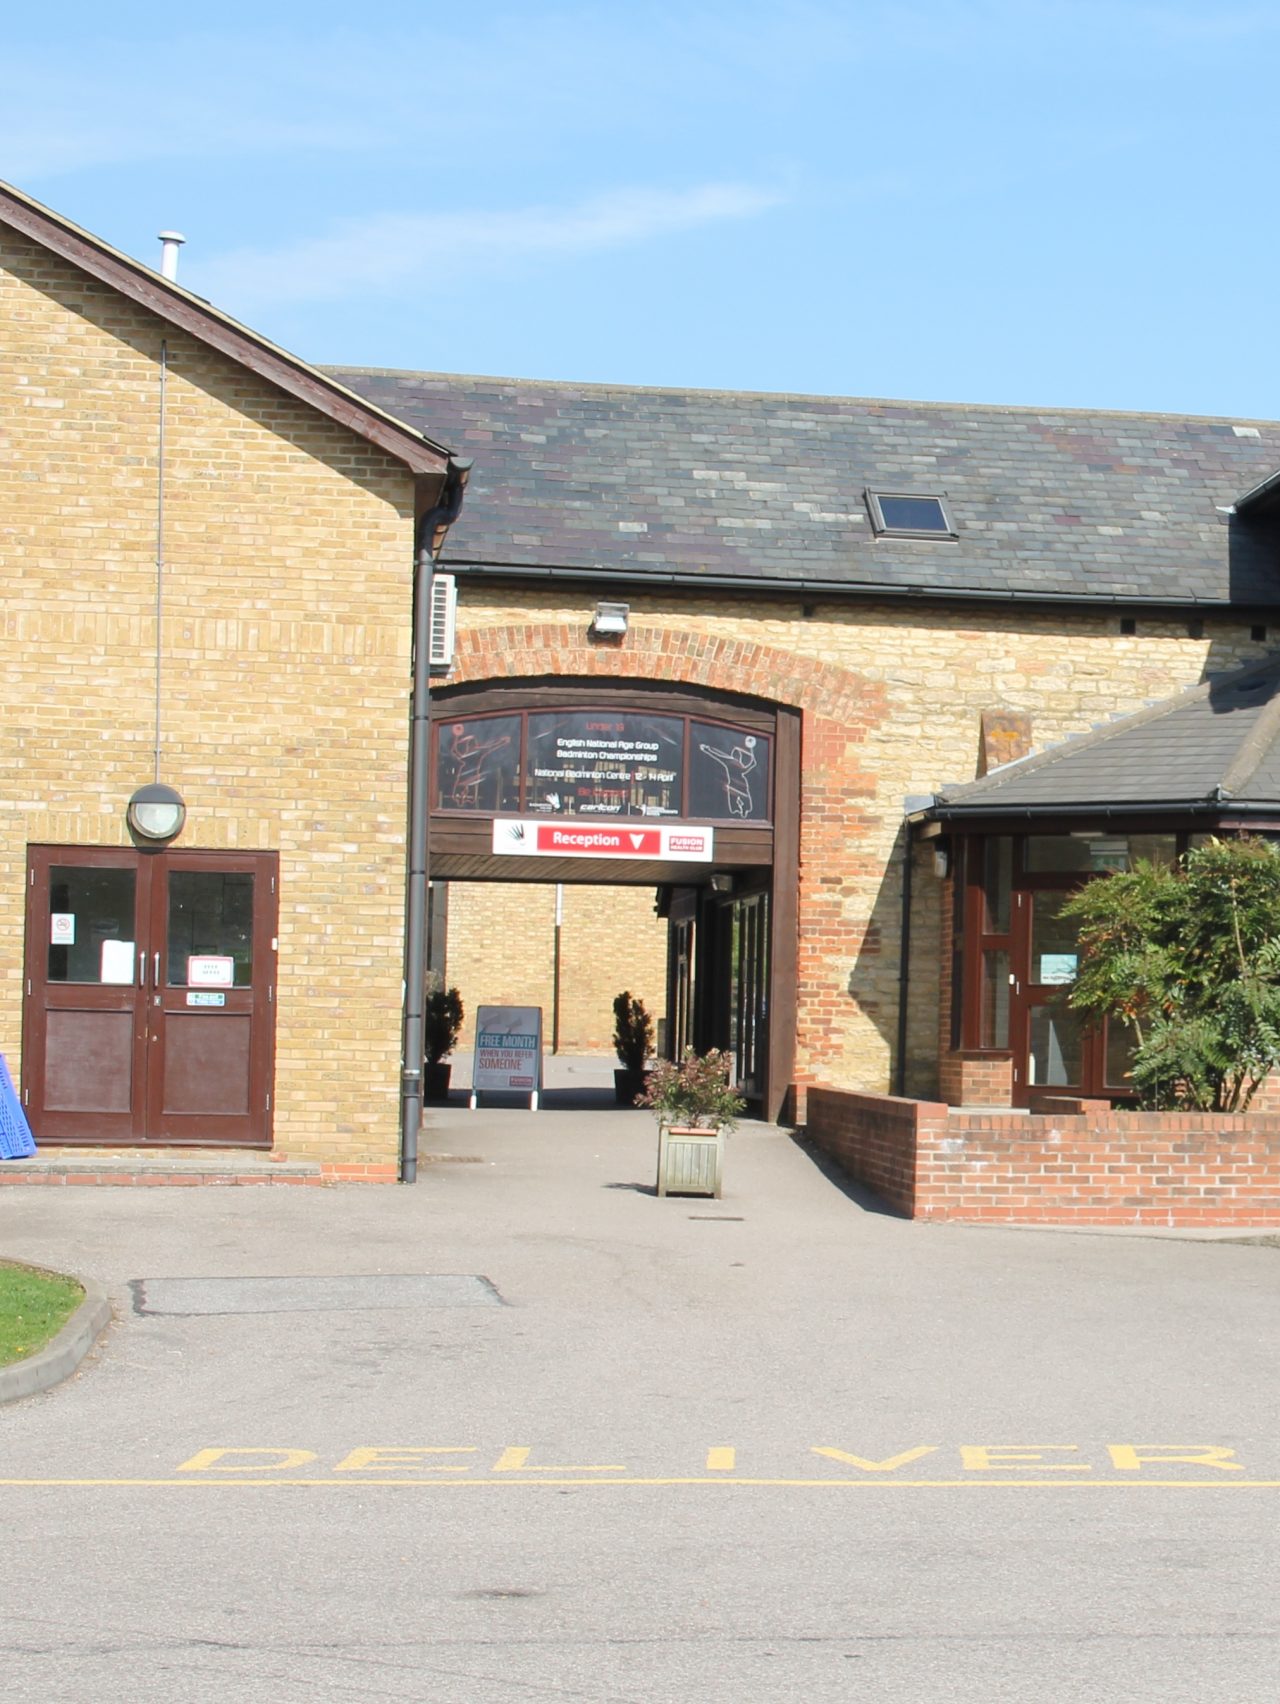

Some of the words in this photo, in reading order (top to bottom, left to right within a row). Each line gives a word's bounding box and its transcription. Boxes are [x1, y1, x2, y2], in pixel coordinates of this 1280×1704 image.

[556, 738, 586, 748] English
[586, 738, 618, 749] National
[618, 740, 635, 750] Age
[635, 741, 660, 751] Group
[556, 750, 598, 759] Badminton
[598, 751, 658, 762] Championships
[534, 768, 565, 777] National
[565, 770, 605, 779] Badminton
[606, 771, 631, 780] Centre
[552, 831, 620, 847] Reception
[670, 838, 704, 846] FUSION
[480, 1035, 500, 1047] FREE
[503, 1035, 535, 1048] MONTH
[480, 1049, 499, 1057] WHEN
[514, 1050, 533, 1058] REFER
[479, 1058, 522, 1070] SOMEONE
